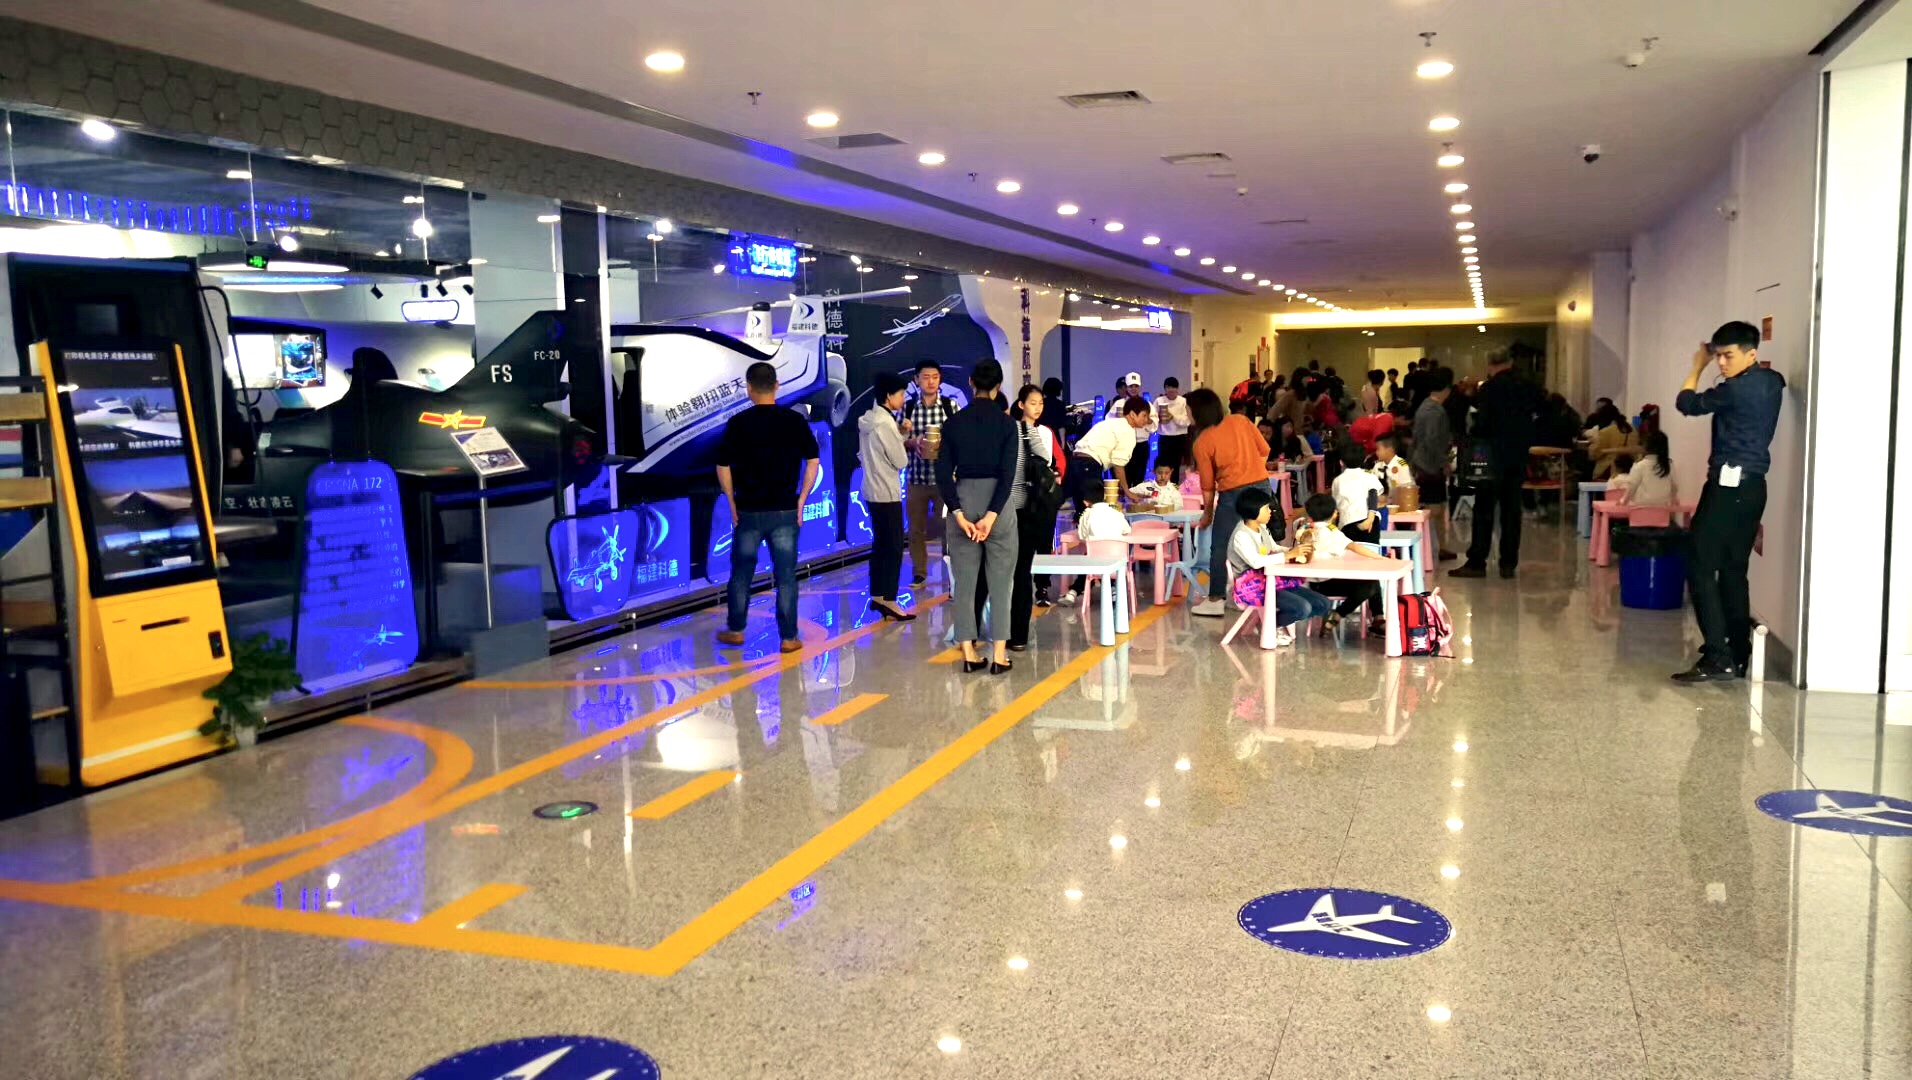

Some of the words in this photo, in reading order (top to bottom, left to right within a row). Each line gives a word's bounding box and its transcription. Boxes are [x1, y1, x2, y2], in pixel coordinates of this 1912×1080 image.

[534, 350, 560, 360] FC-20
[491, 364, 513, 383] FS
[364, 477, 382, 489] 172
[637, 559, 679, 584] 福建科德
